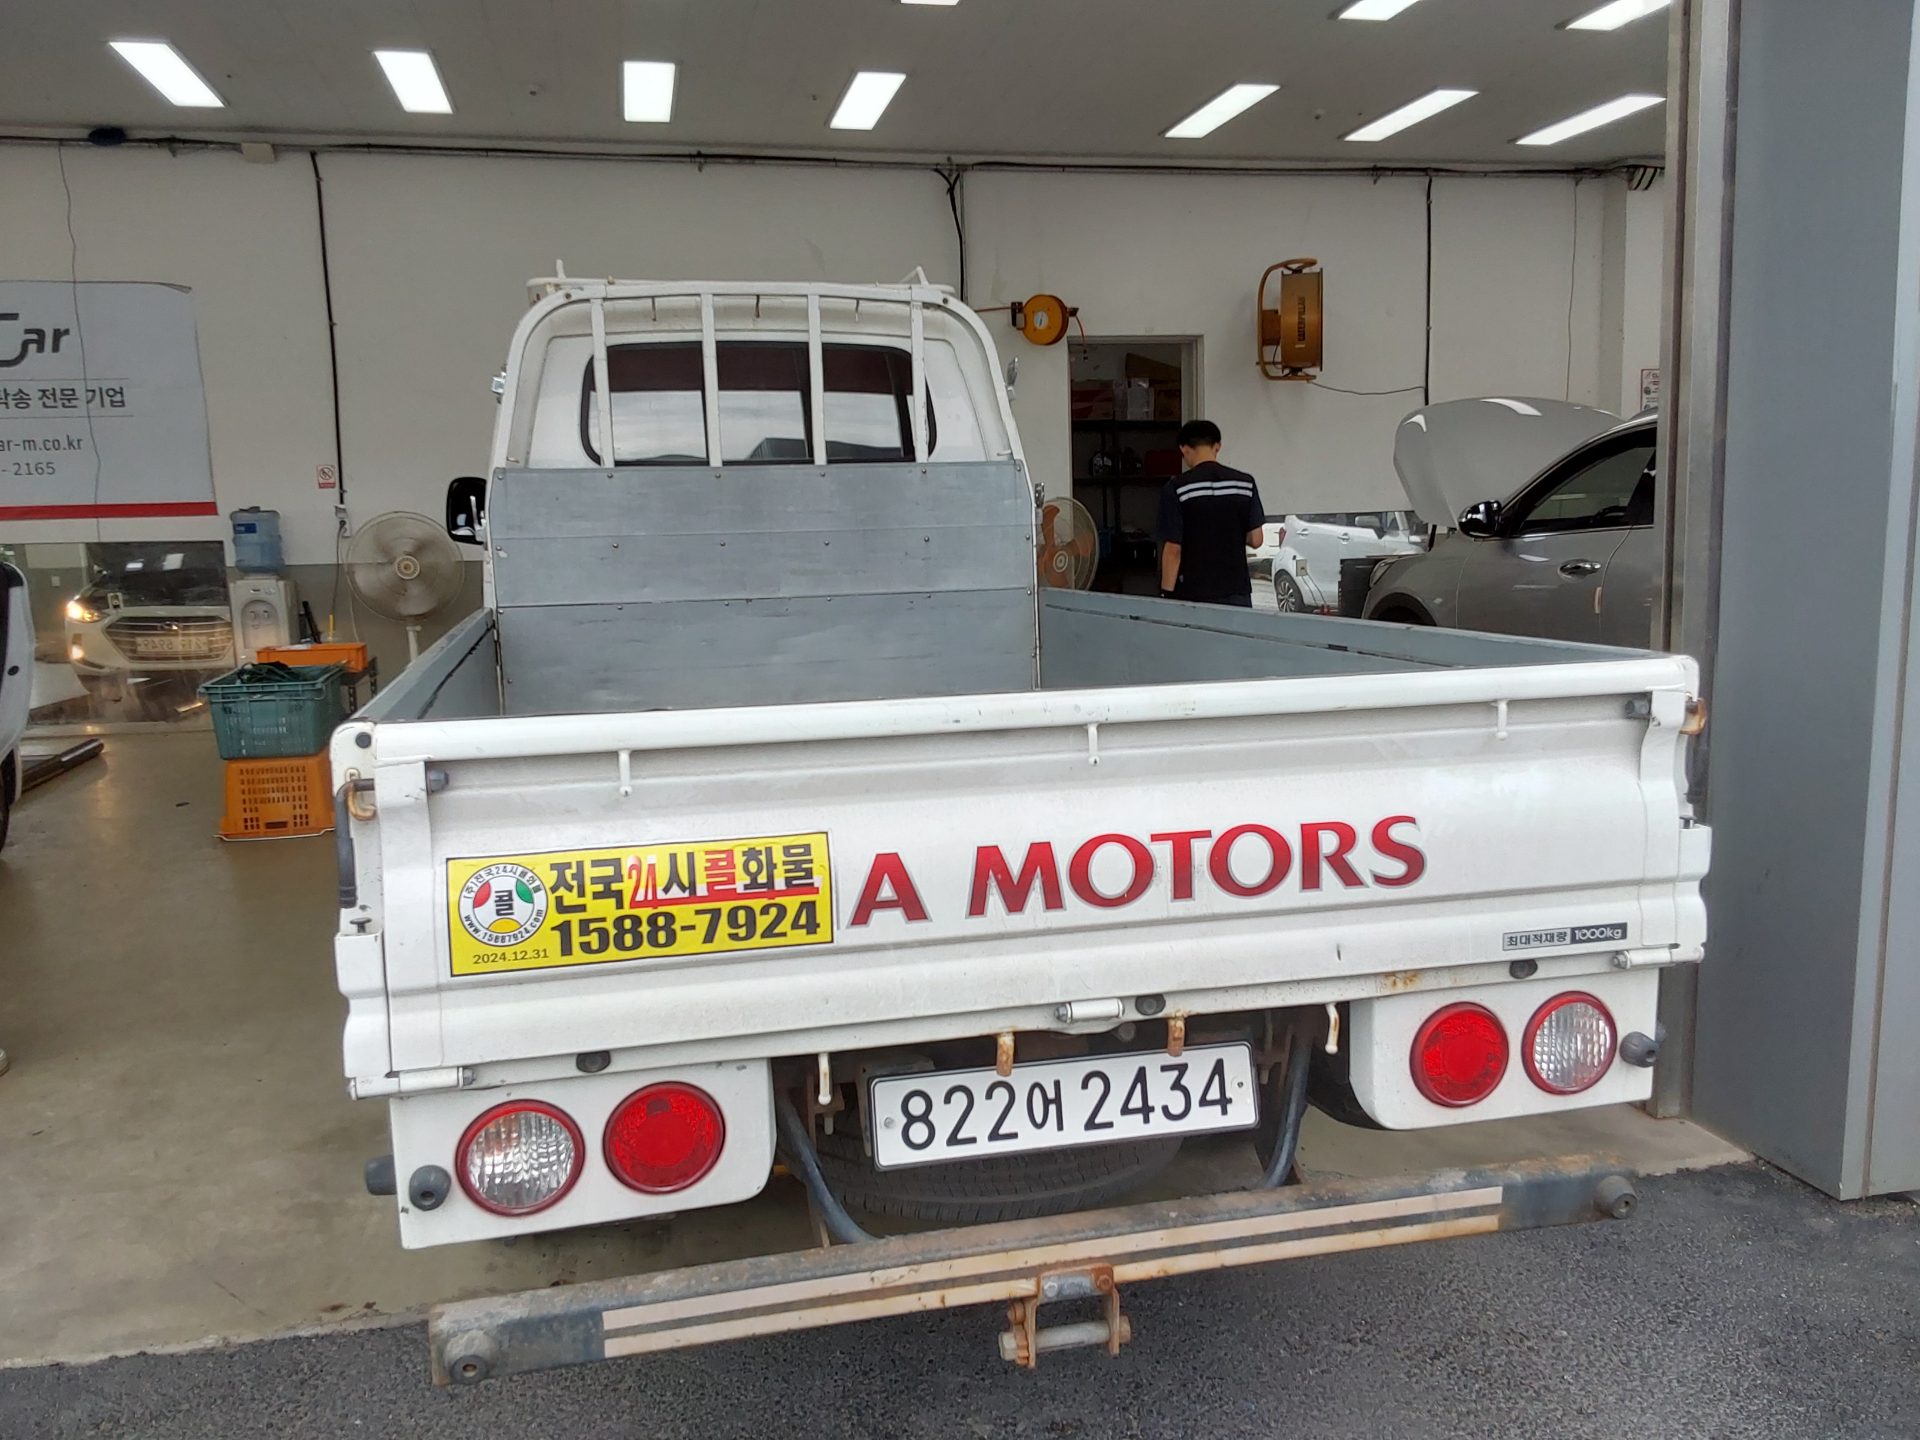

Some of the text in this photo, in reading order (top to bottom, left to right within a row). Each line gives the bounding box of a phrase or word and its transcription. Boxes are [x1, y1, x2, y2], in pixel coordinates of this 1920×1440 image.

[37, 387, 80, 409] 전문
[85, 386, 126, 409] 기업
[12, 461, 56, 477] 2165
[847, 815, 1427, 930] A MOTORS
[550, 901, 820, 957] 1588-7924
[1506, 927, 1622, 946] 최대적재량 1000kg
[472, 948, 549, 965] 2024.12.31
[900, 1057, 1233, 1151] 822어 2434
